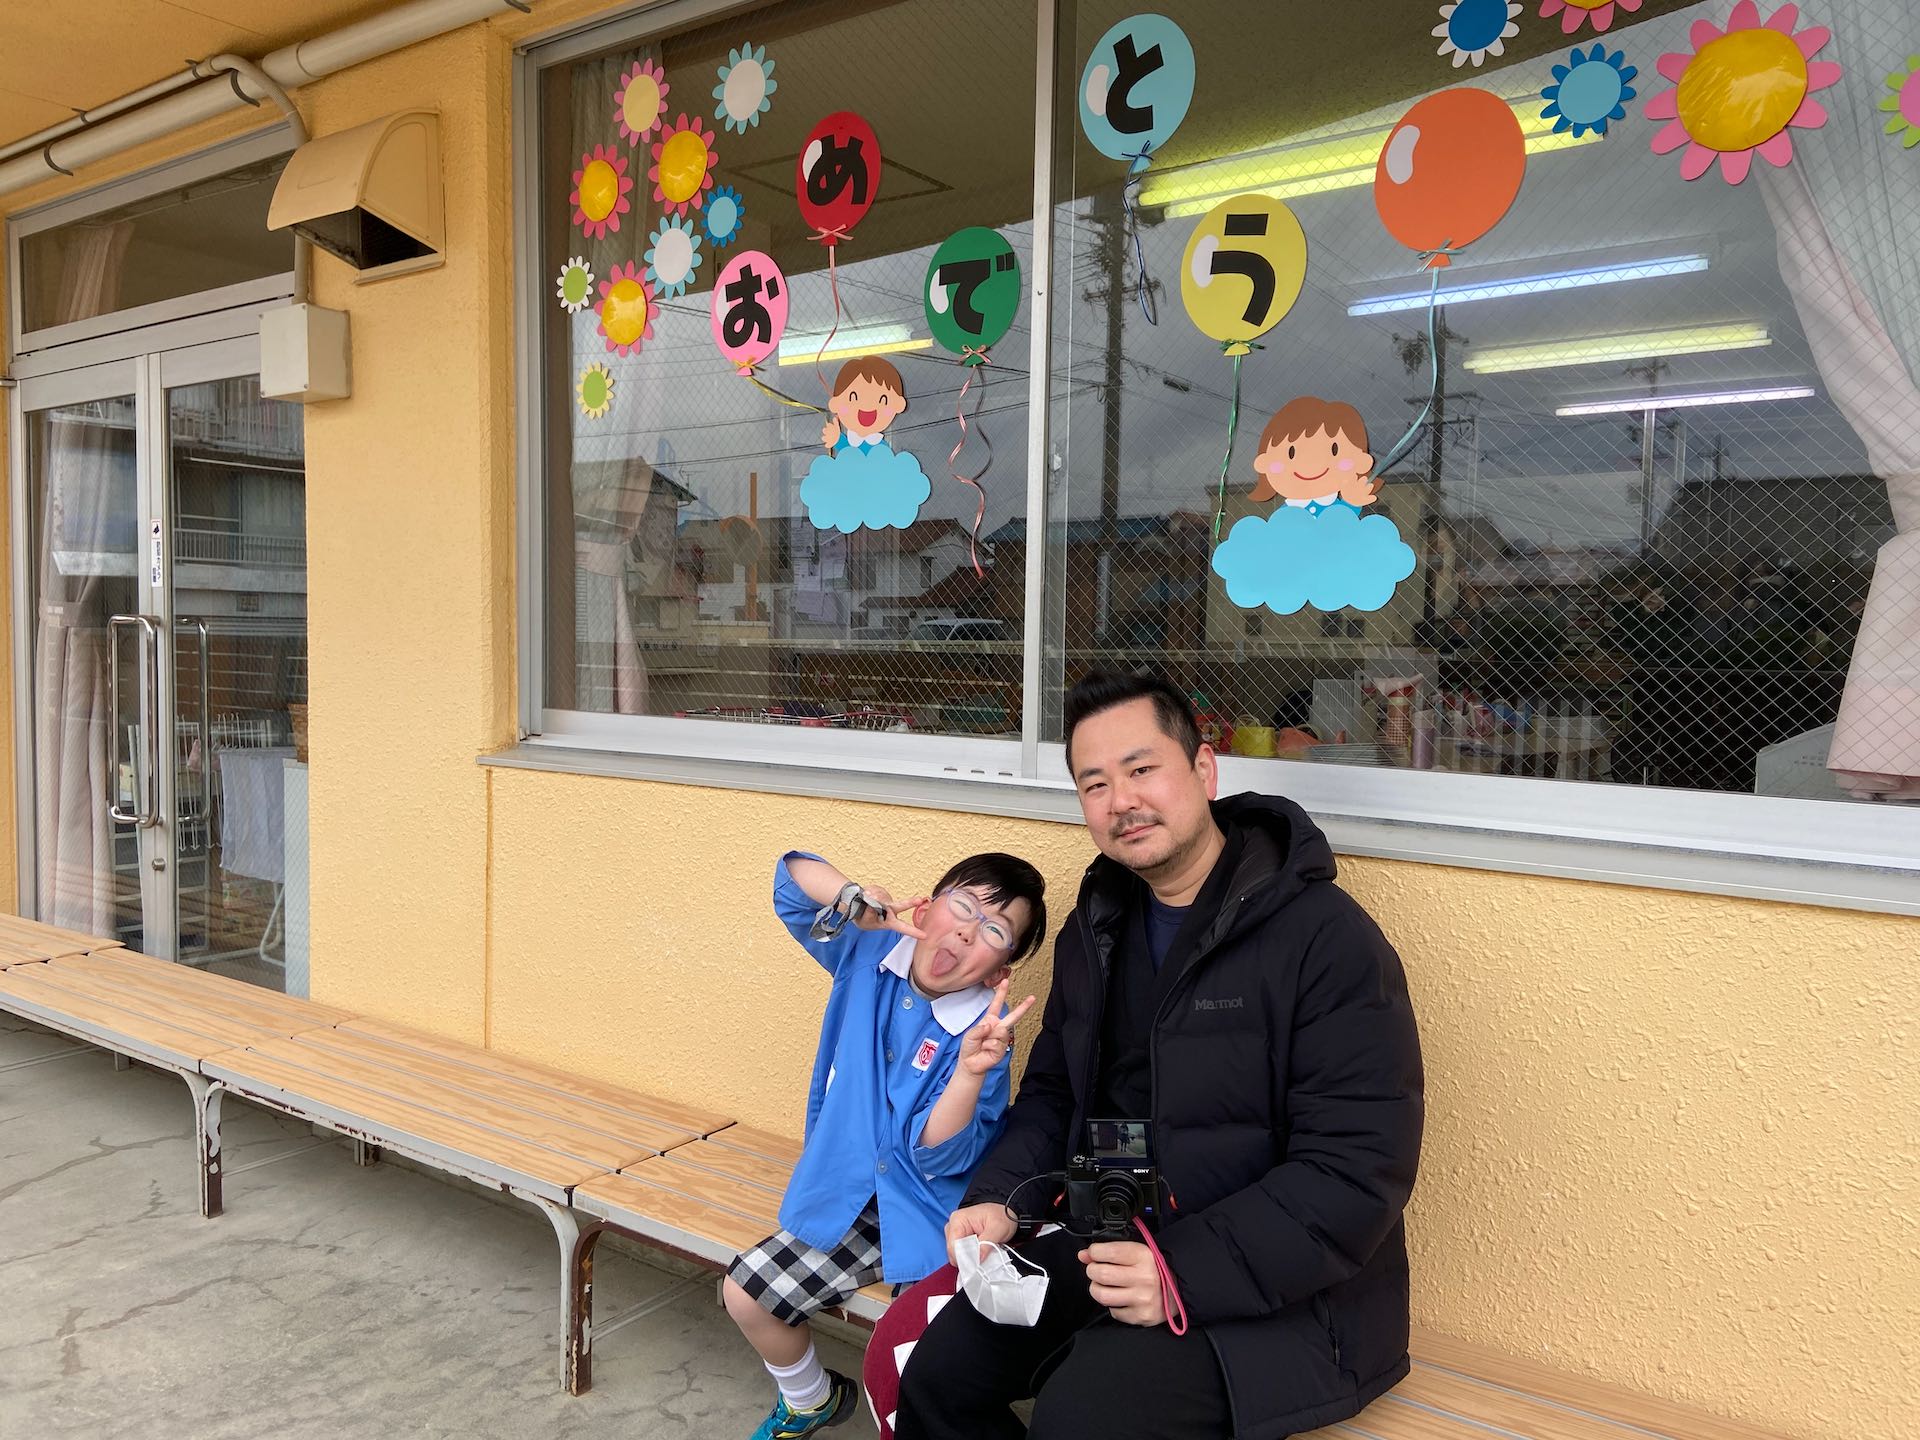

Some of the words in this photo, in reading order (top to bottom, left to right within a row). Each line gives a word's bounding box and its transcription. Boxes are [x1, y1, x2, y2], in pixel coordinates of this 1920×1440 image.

[722, 263, 779, 348] お
[806, 134, 868, 206] め
[938, 250, 1016, 336] で
[1105, 33, 1165, 135] と
[1209, 213, 1276, 327] う
